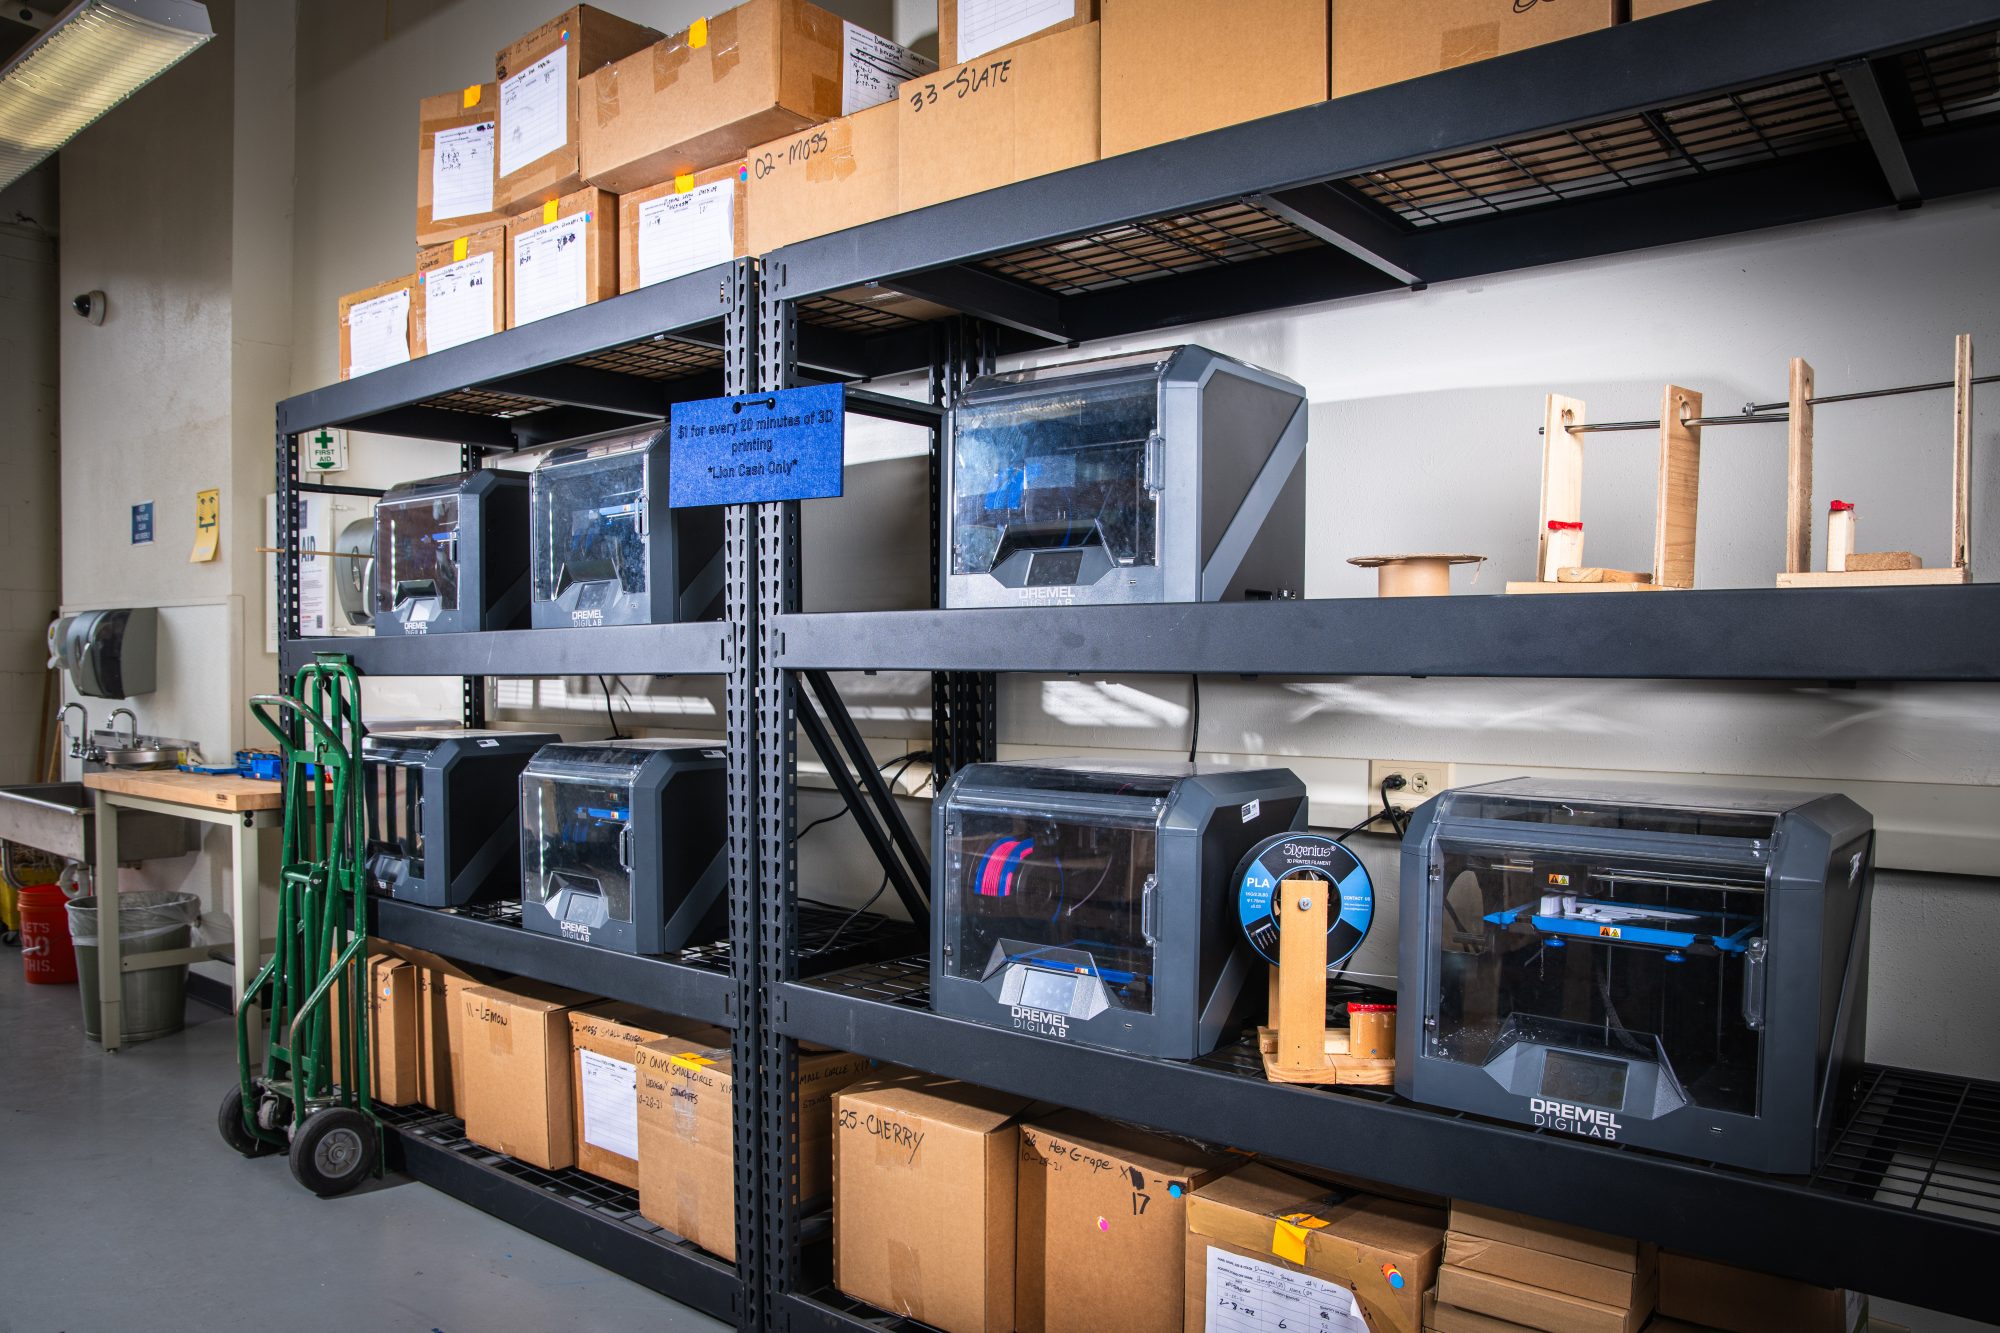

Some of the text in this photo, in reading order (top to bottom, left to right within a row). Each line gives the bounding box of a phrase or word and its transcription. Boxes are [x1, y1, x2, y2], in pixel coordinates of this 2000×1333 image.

[677, 409, 833, 439] $1 for every 20 minutes of 3D
[731, 438, 773, 456] printing
[738, 463, 764, 477] Cash
[1019, 586, 1075, 598] DREMEL
[571, 609, 604, 621] DREMEL
[573, 618, 602, 627] DIGILAB
[404, 621, 428, 630] DREMEL
[1246, 877, 1270, 888] PLA
[561, 921, 591, 935] DREMEL
[562, 929, 590, 943] DIGILAB
[1011, 1006, 1070, 1029] DREMEL
[1014, 1018, 1066, 1038] DIGILAB
[649, 1055, 670, 1074] ONYX
[691, 1072, 714, 1087] CIRCLE
[1530, 1097, 1622, 1129] DREMEL
[1534, 1113, 1616, 1141] DIGILAB
[1048, 1139, 1067, 1156] Hex
[1069, 1147, 1113, 1174] Grape
[1132, 1191, 1151, 1216] 17
